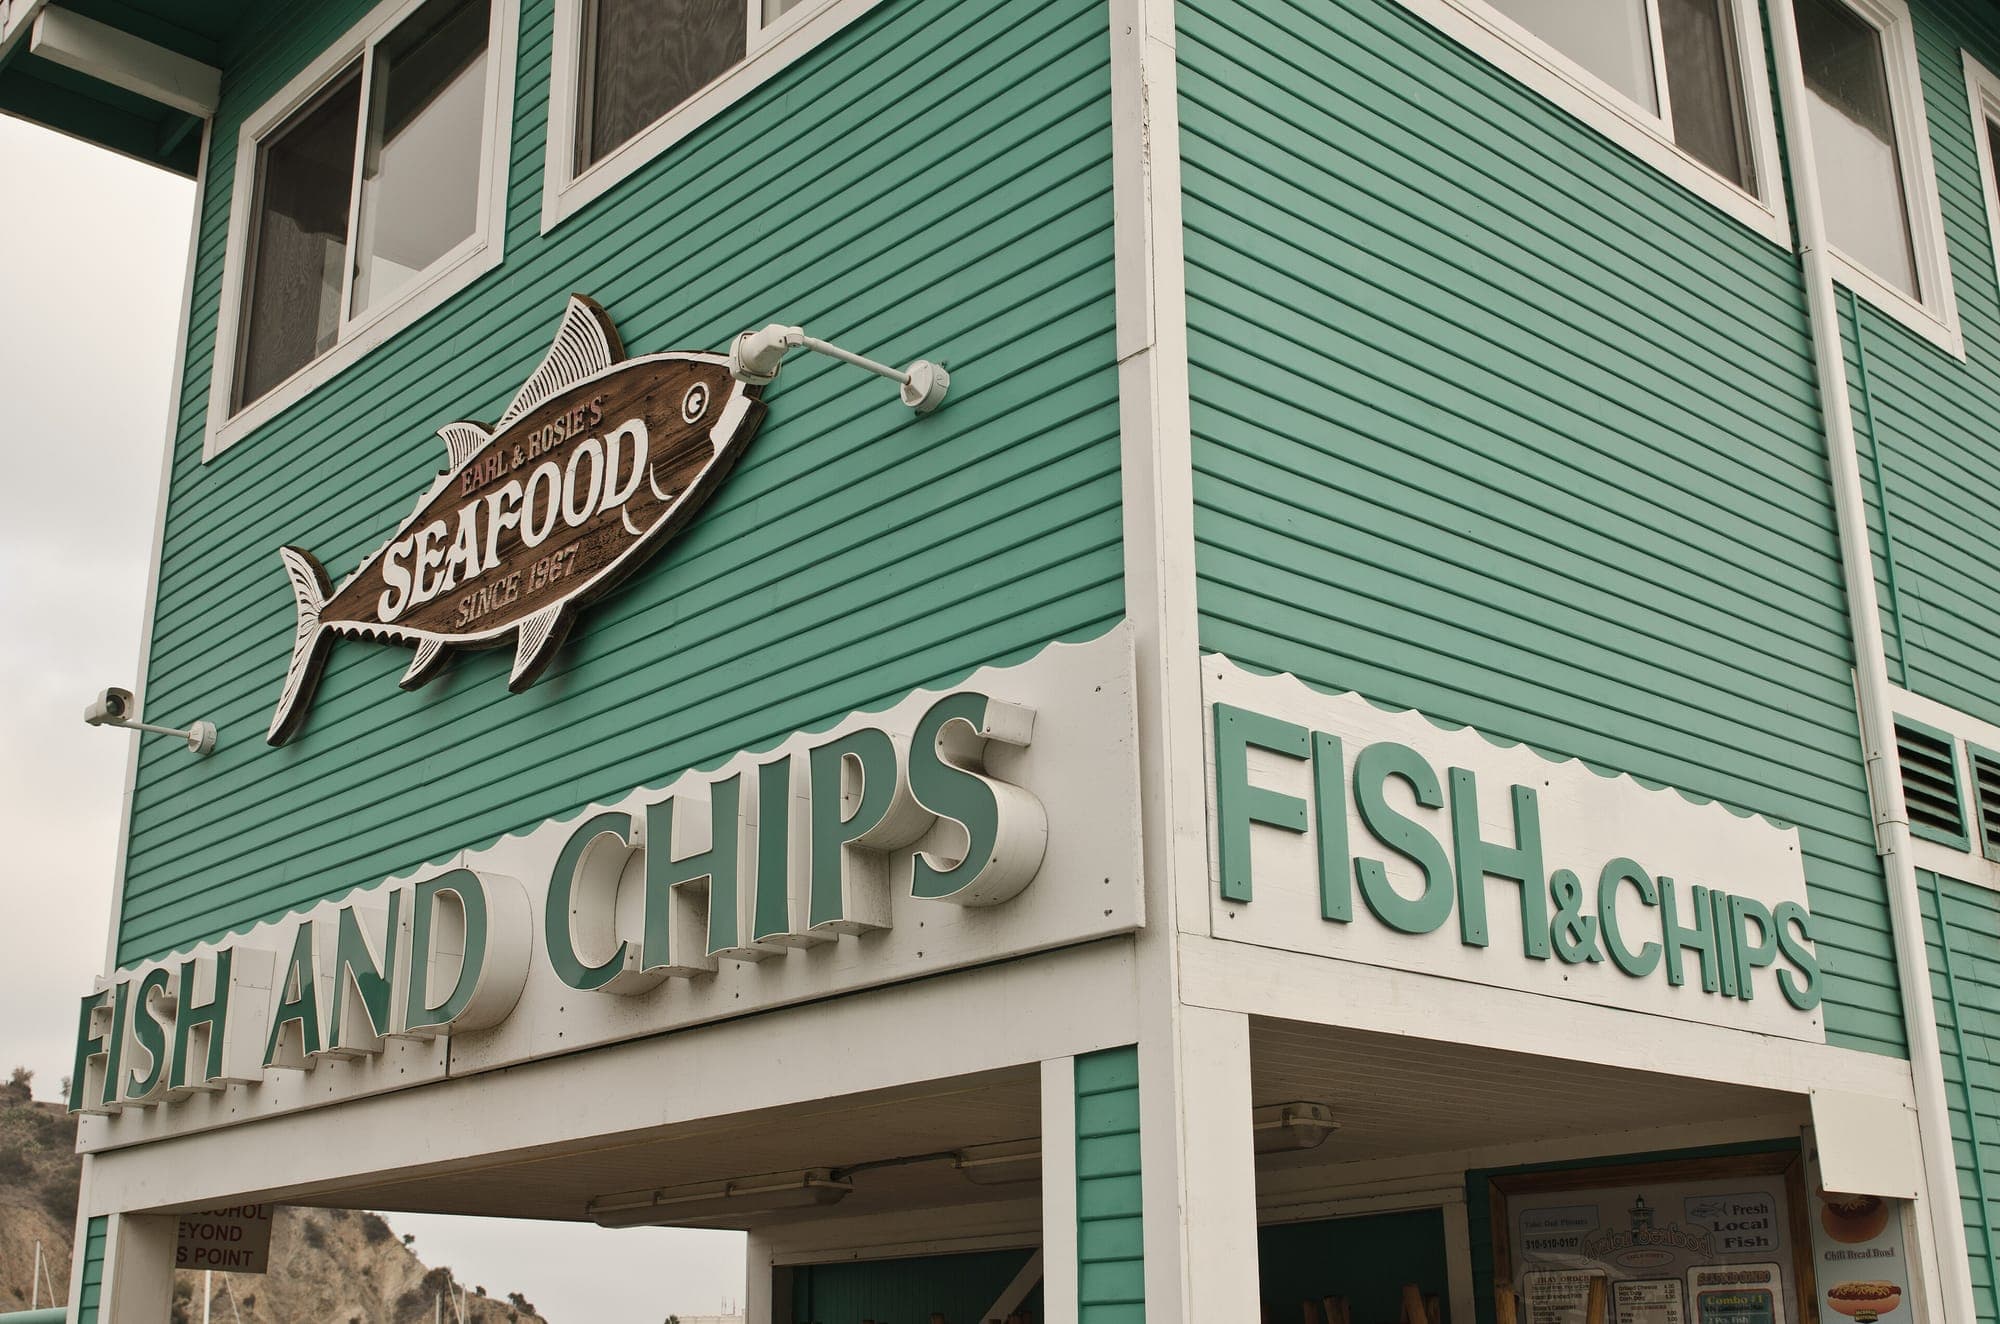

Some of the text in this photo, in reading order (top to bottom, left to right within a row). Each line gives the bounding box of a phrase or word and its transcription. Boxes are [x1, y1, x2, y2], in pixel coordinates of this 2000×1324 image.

[461, 396, 603, 498] EARL & ROSIE'S
[377, 418, 649, 624] SEAFOOD
[456, 570, 521, 628] SINCE
[68, 691, 1000, 1114] FISH AND CHIPS
[1732, 1203, 1769, 1215] Fresh
[1712, 1218, 1769, 1232] Local
[1725, 1236, 1769, 1249] Fish
[194, 1247, 254, 1267] POINT
[1825, 1247, 1894, 1261] Chili Bread Bowl
[1706, 1295, 1748, 1305] Combo
